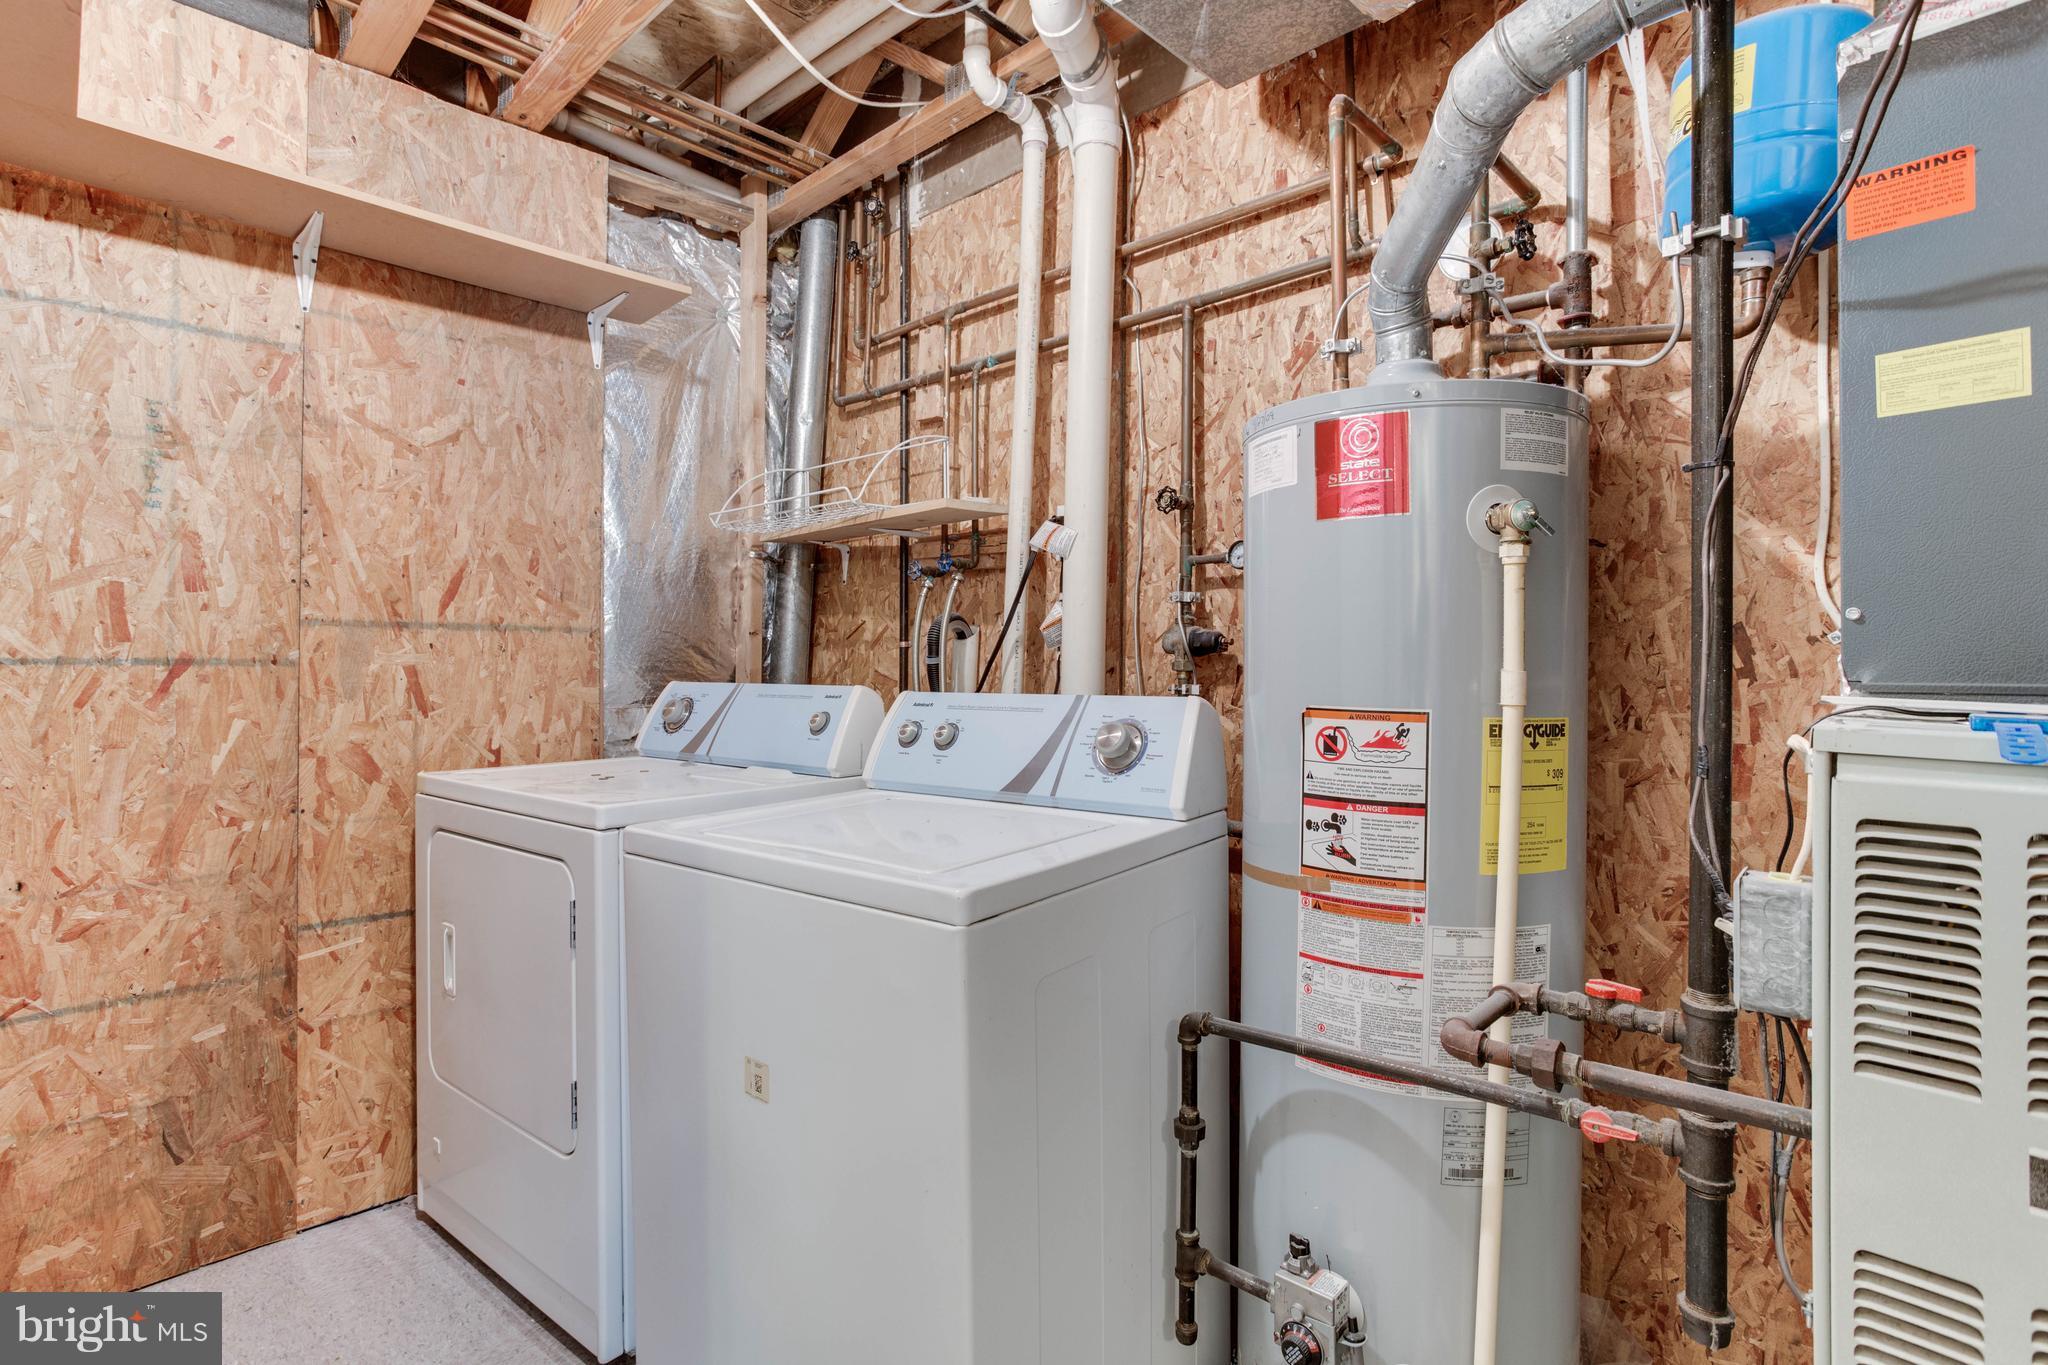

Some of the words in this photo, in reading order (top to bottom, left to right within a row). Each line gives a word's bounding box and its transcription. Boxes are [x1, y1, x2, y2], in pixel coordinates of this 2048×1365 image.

[1853, 150, 1967, 188] WARNING
[1340, 458, 1380, 470] state
[1328, 468, 1393, 484] SELECT
[1489, 723, 1566, 739] EGYGUIDE
[1552, 769, 1563, 778] 309
